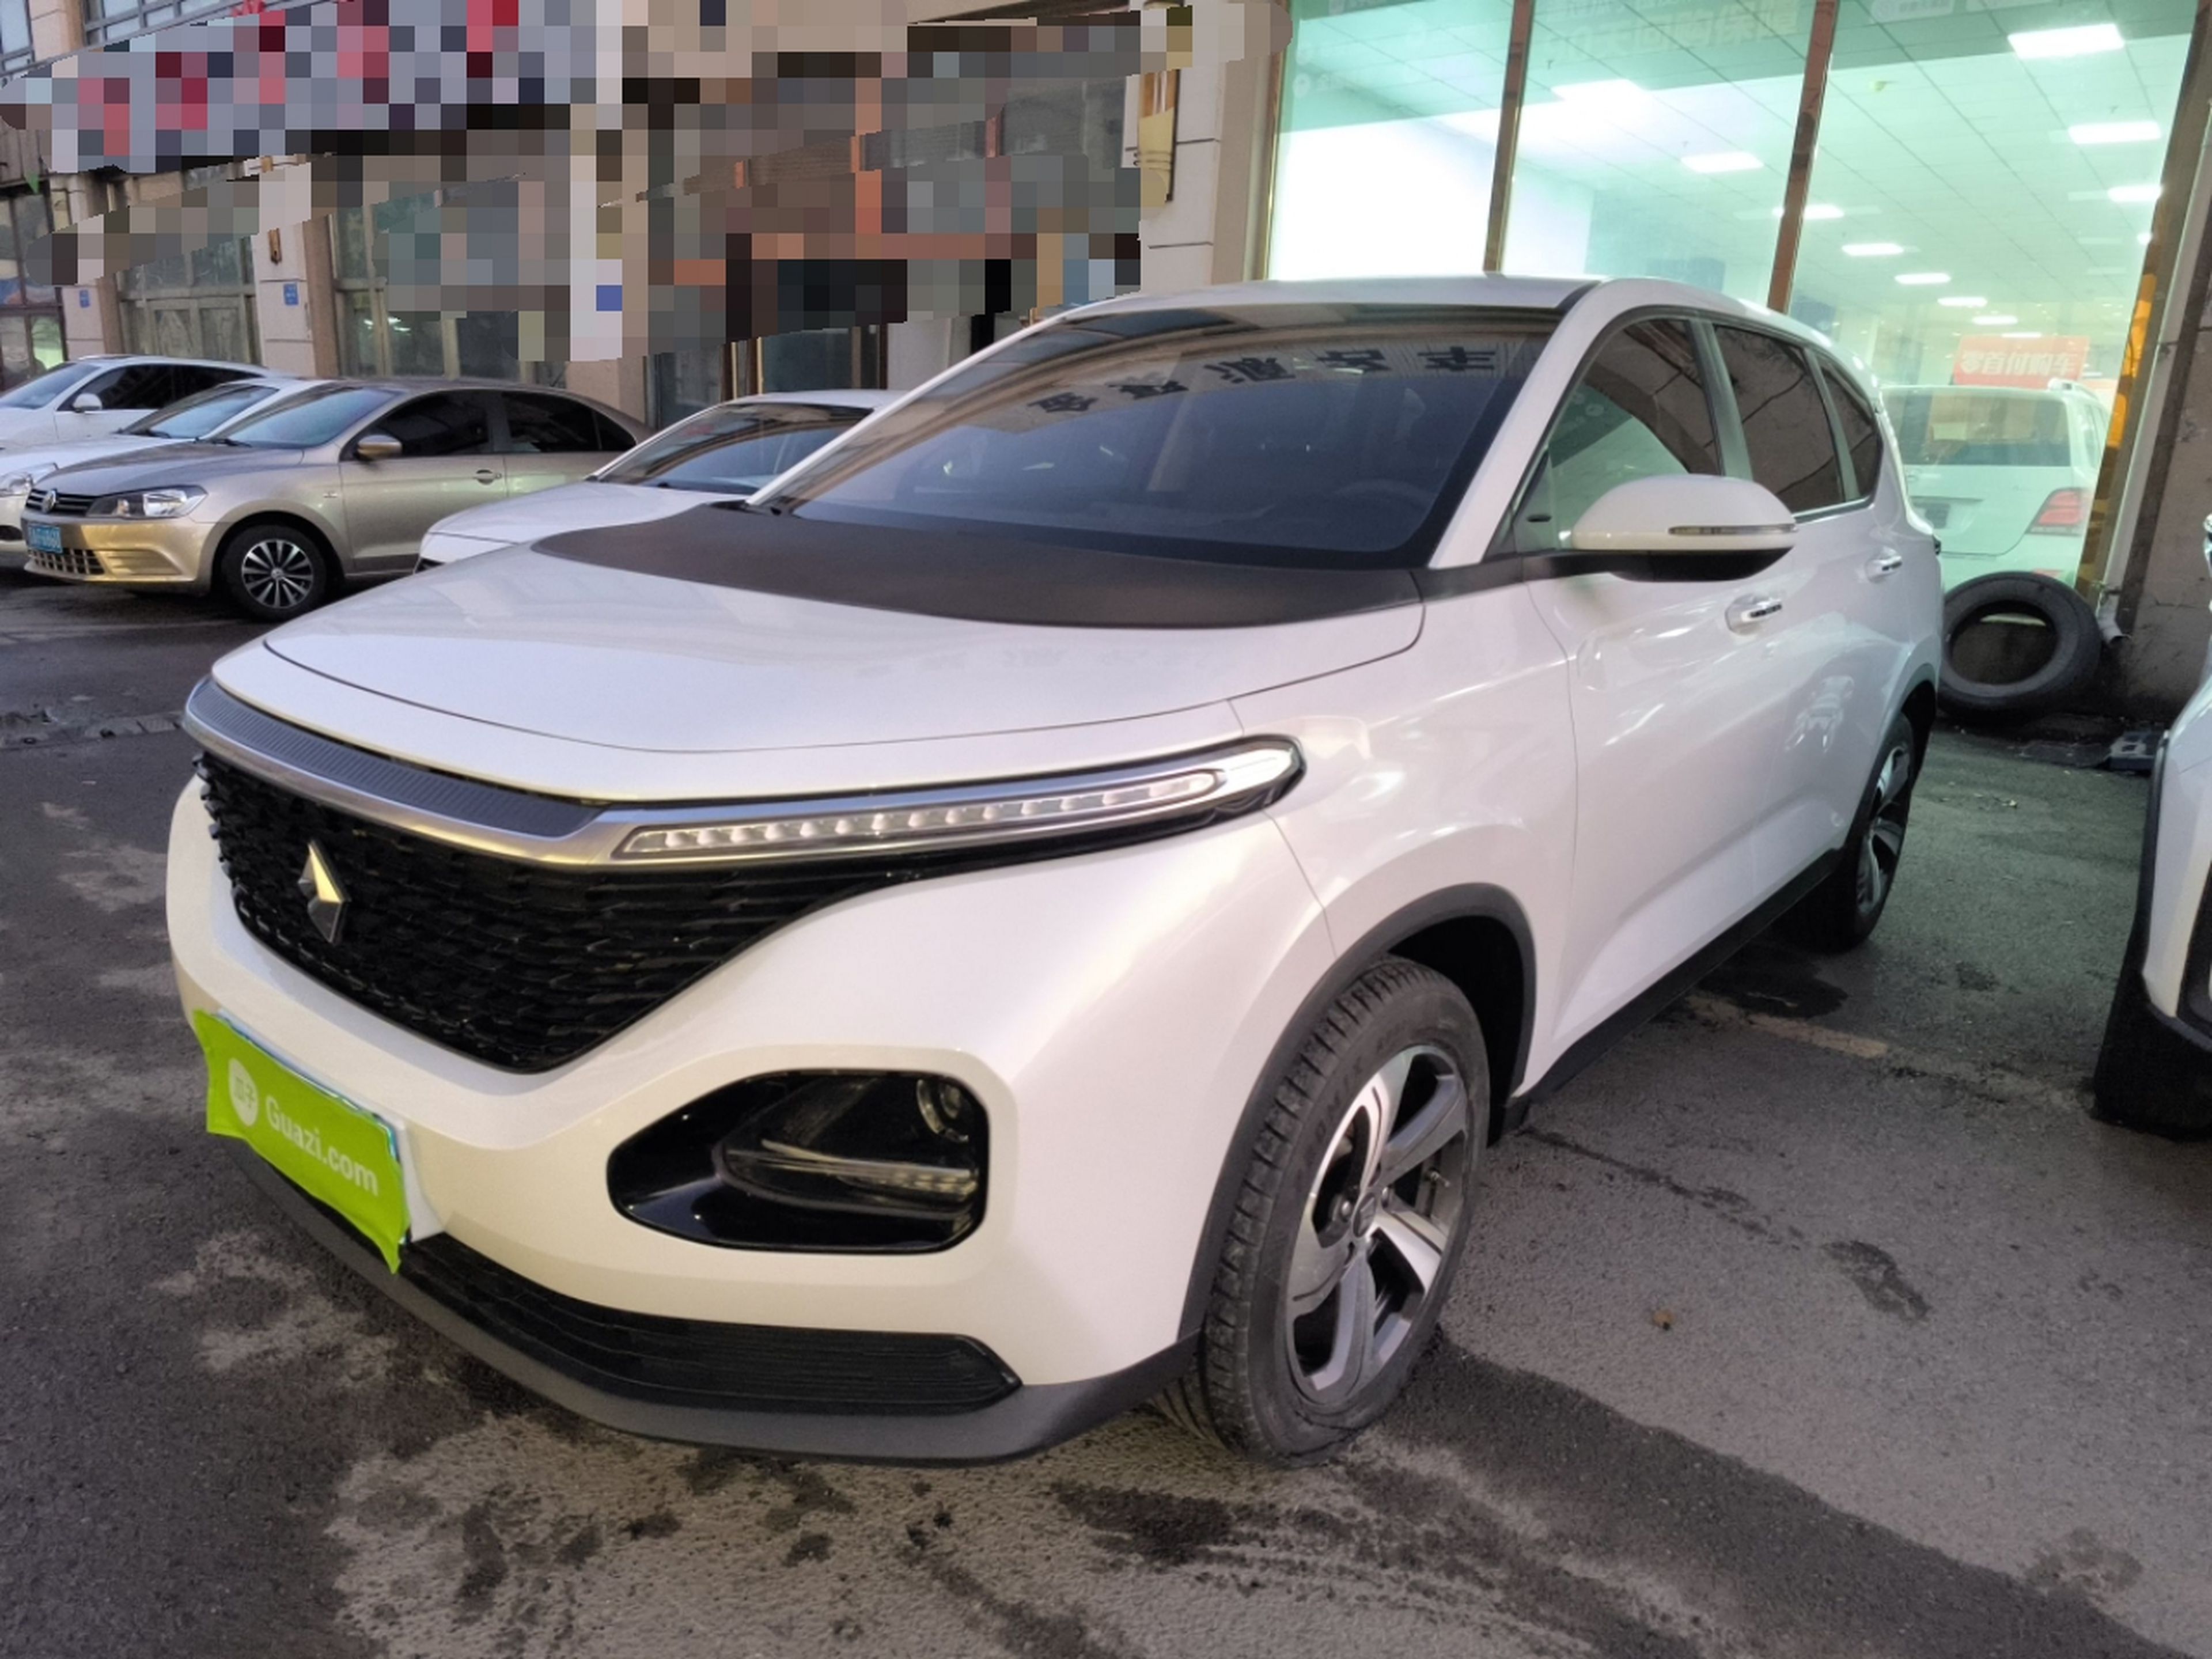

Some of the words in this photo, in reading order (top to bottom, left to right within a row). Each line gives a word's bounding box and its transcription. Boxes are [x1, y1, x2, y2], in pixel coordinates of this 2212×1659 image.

[1959, 352, 2078, 376] 零首付购车
[266, 1094, 378, 1196] Guazi.com
